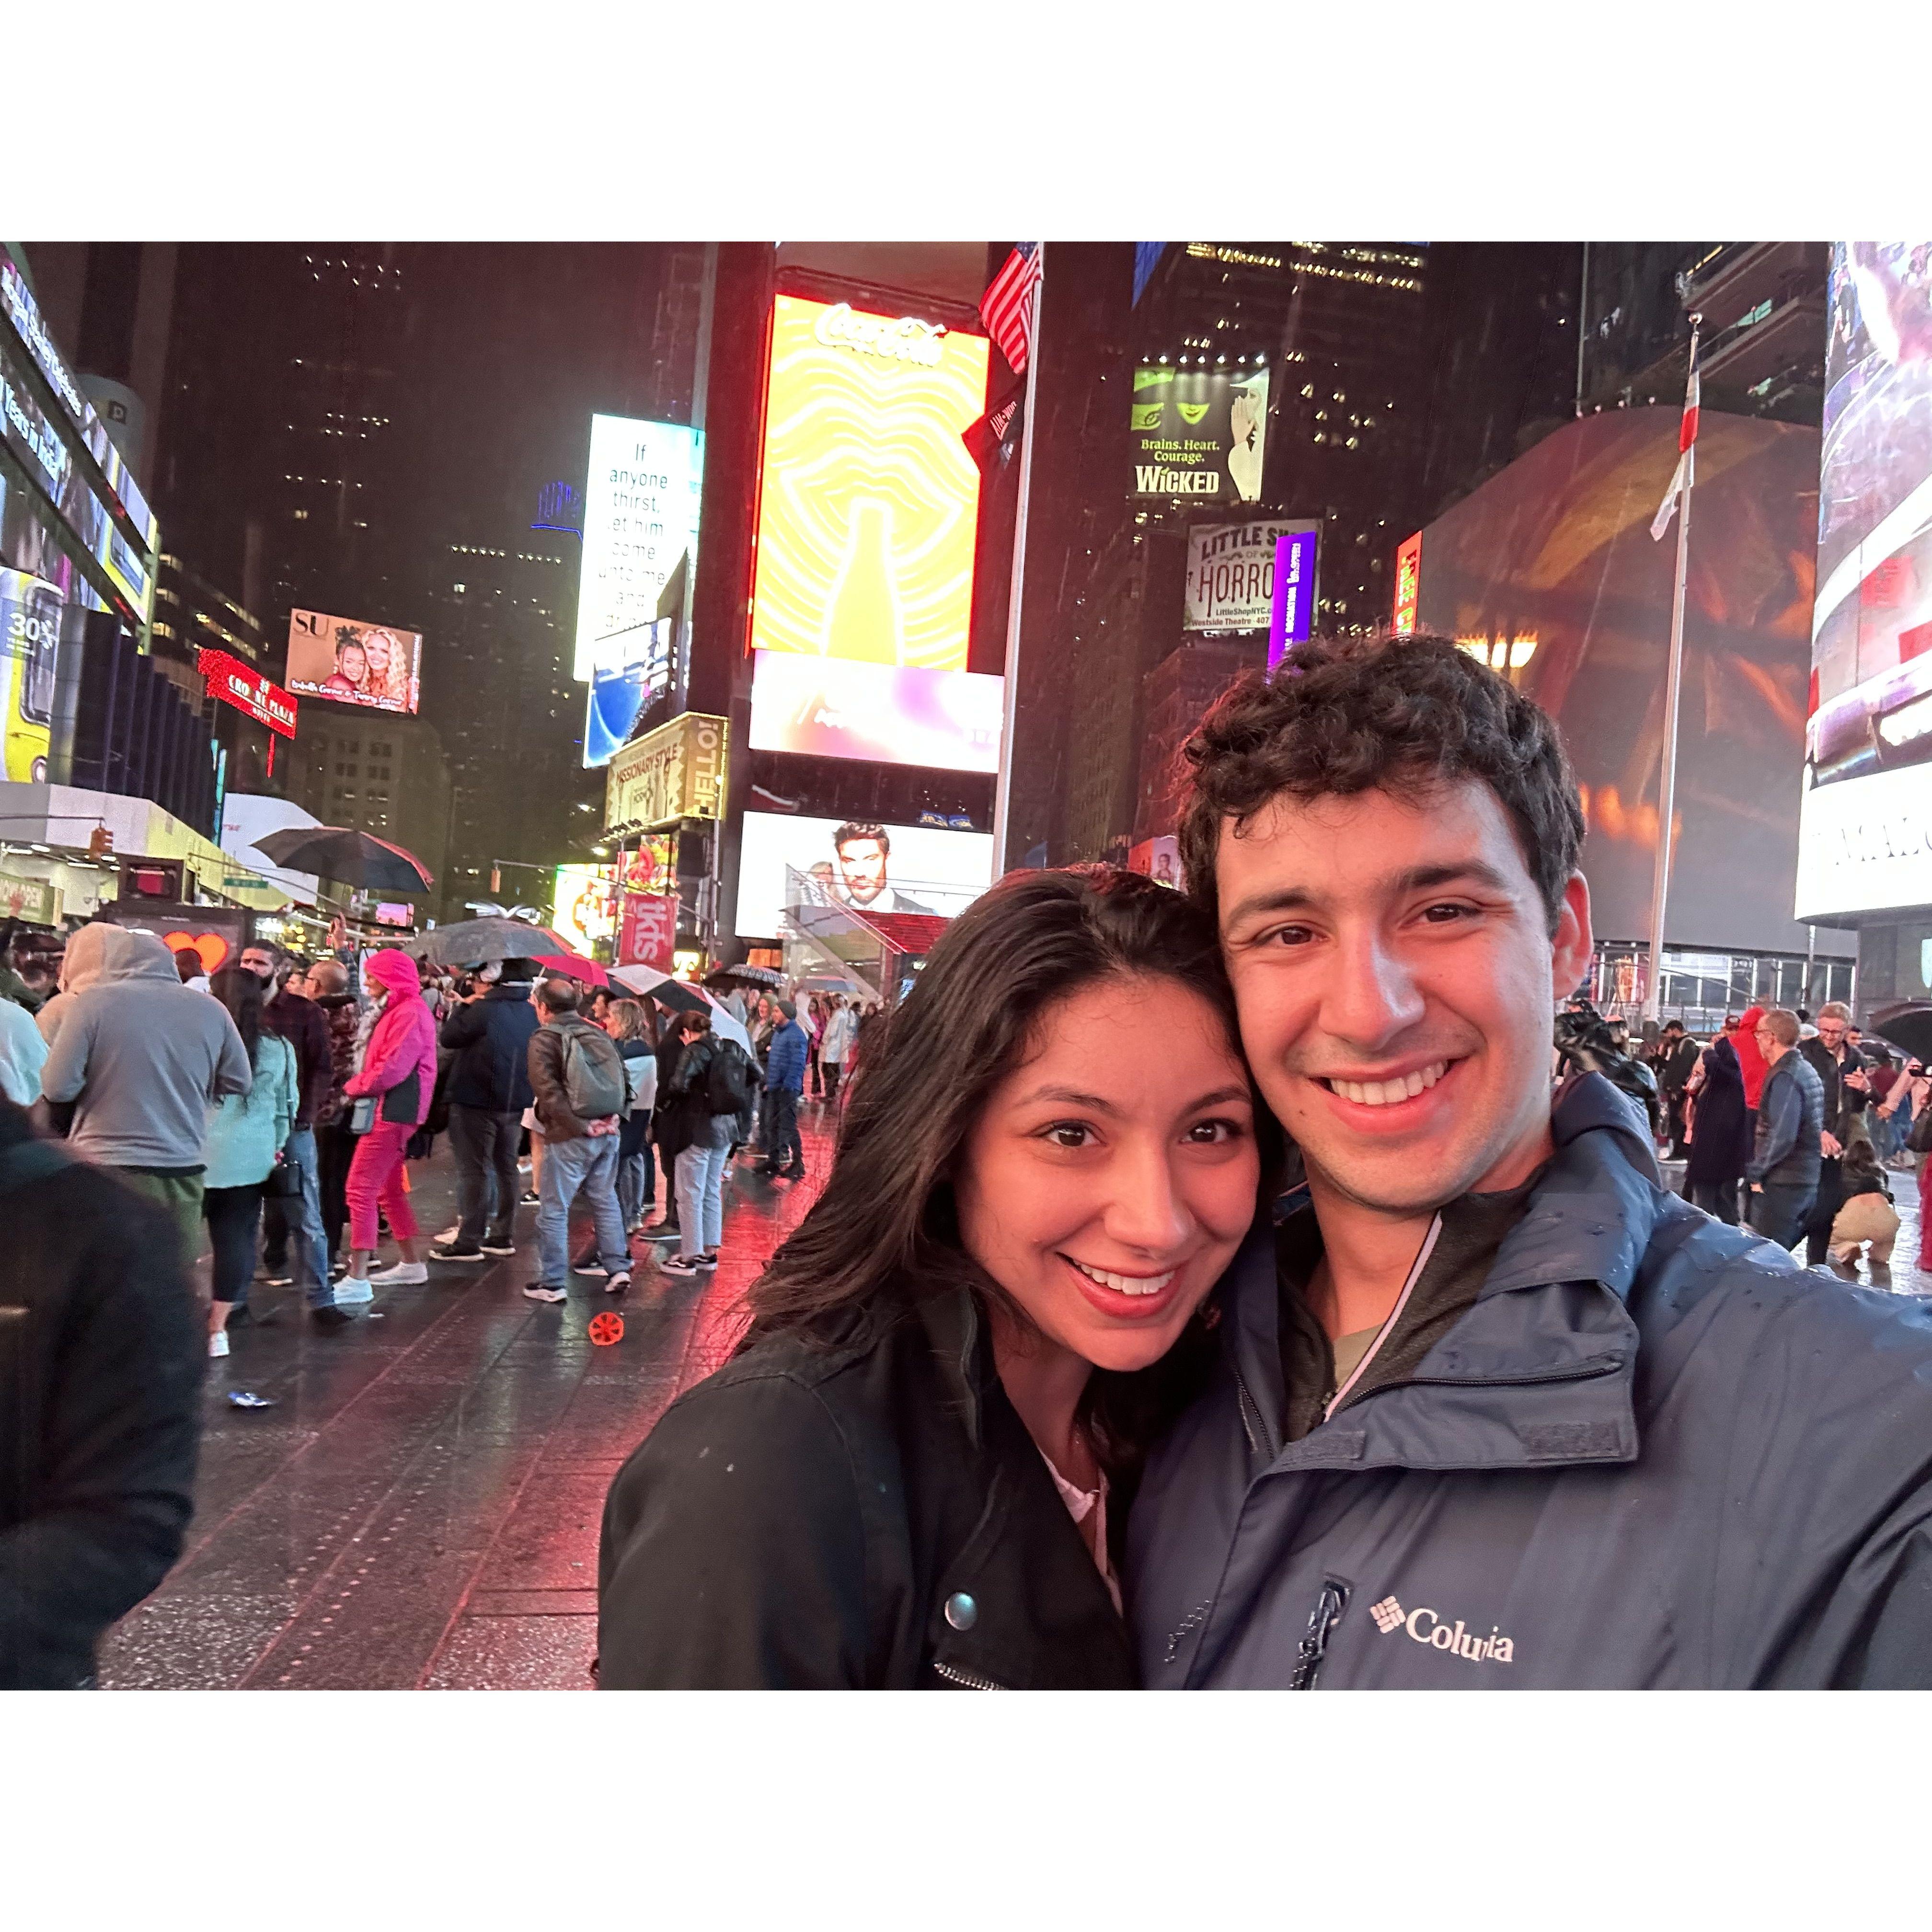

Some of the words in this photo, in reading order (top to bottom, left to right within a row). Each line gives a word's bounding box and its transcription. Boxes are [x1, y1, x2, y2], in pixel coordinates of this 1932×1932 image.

[635, 443, 647, 461] If
[1141, 438, 1182, 450] Brains.
[1184, 439, 1220, 450] Heart.
[1154, 450, 1205, 465] Courage.
[610, 470, 667, 490] anyone
[607, 517, 627, 531] et
[1202, 526, 1263, 561] LITTLE
[1198, 562, 1276, 617] HORRO
[1216, 607, 1273, 616] LittleShopNYC.c
[1225, 618, 1251, 626] Theatre
[693, 720, 719, 816] HELLO!
[633, 897, 667, 960] tkts
[1405, 1608, 1514, 1662] Coluia
